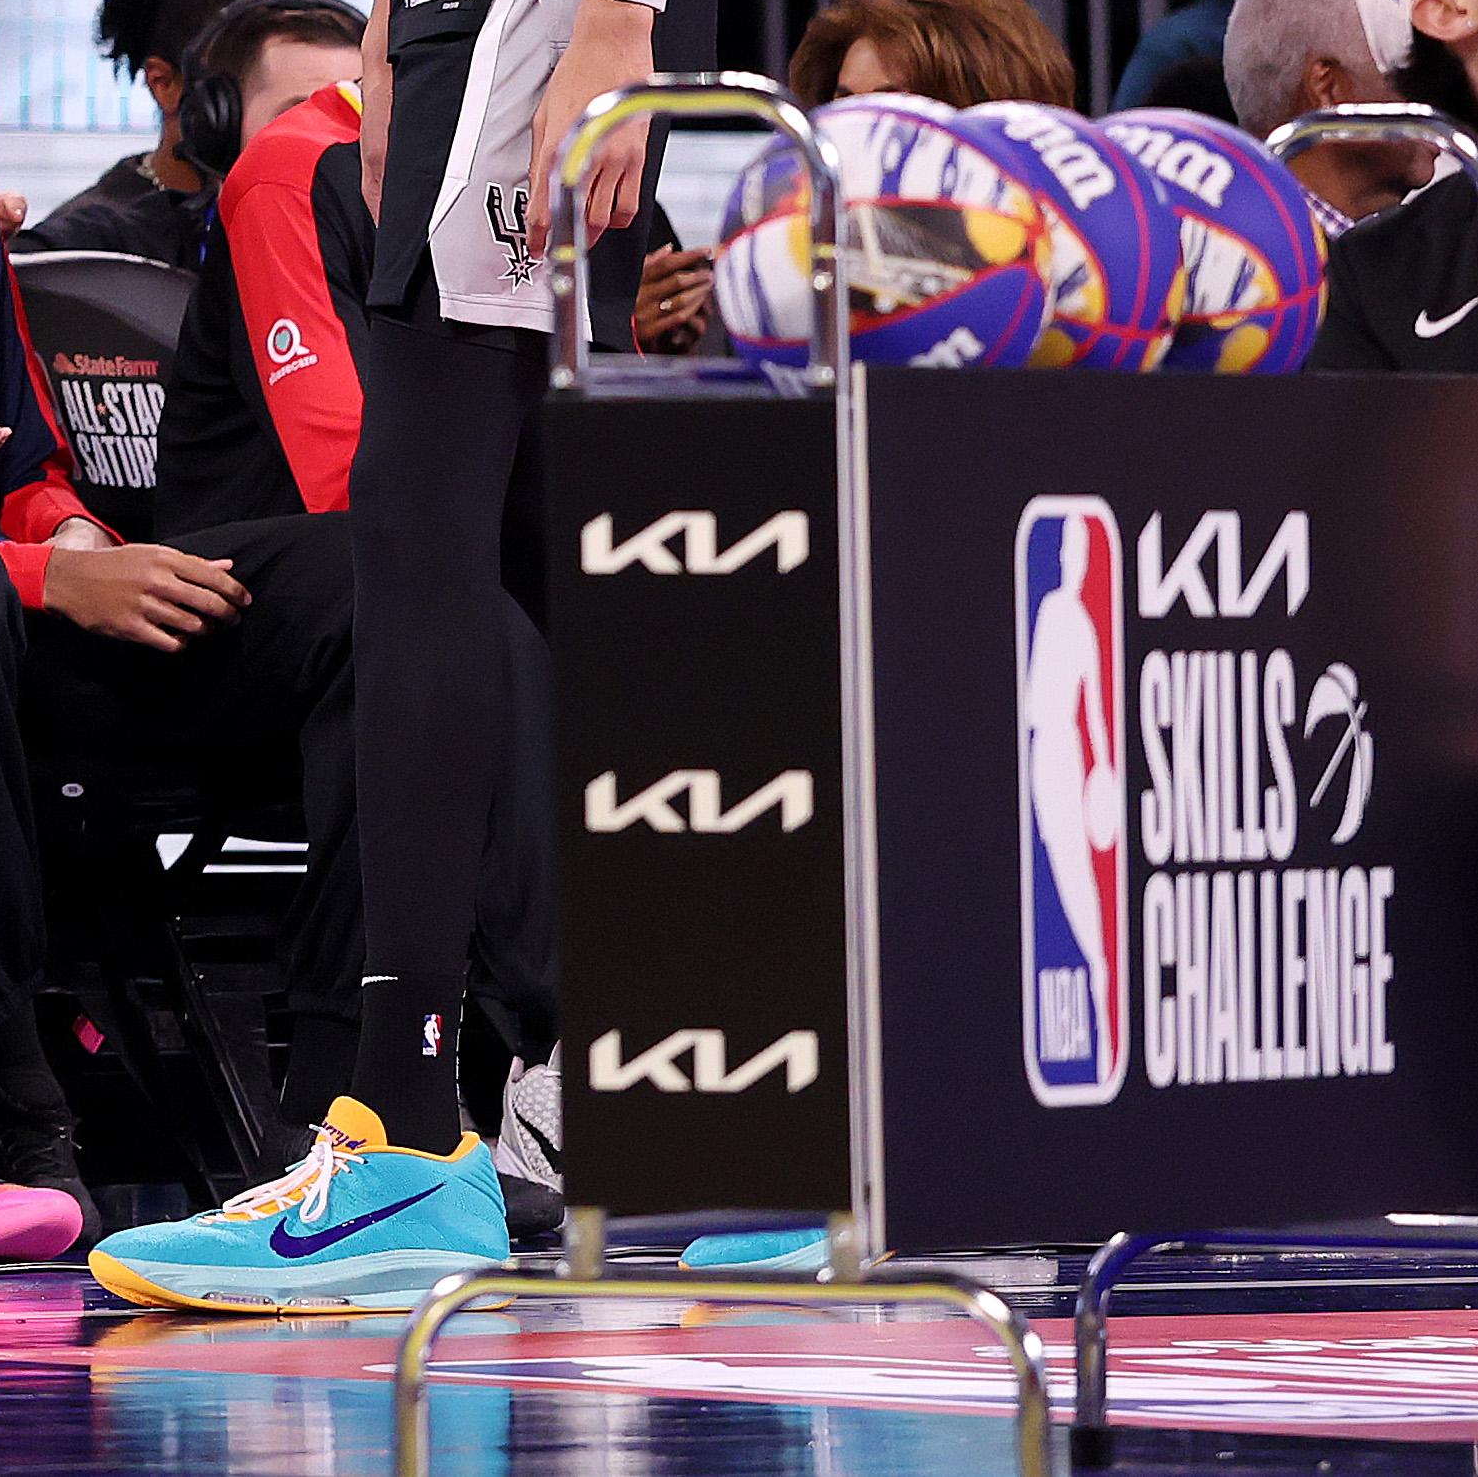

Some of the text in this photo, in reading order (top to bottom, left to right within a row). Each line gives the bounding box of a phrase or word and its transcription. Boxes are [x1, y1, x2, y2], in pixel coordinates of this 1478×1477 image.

[1139, 647, 1297, 867] SKILLS
[1038, 965, 1092, 1062] NBA
[1142, 864, 1396, 1089] CHALLENGE
